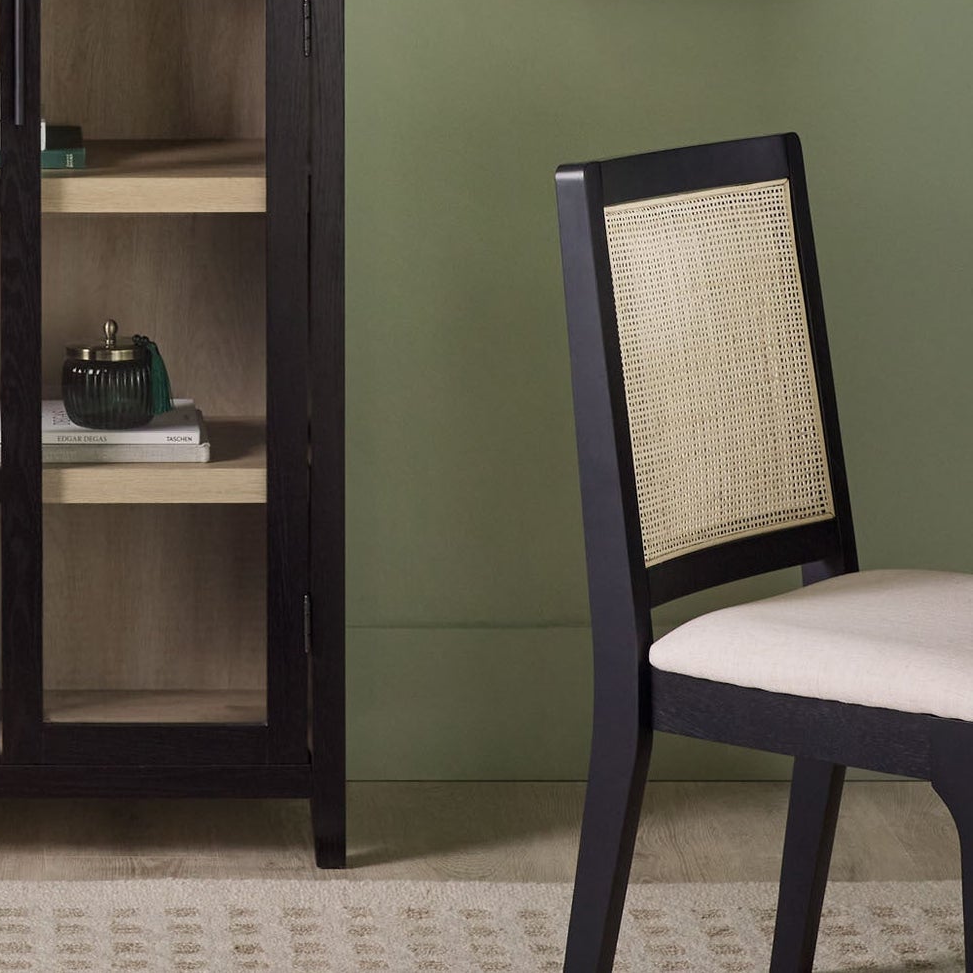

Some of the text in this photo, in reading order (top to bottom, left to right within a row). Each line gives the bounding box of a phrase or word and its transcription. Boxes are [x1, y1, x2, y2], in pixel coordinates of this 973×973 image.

[57, 435, 108, 443] EDGAR DEGAS
[166, 435, 193, 443] TASCHEN
